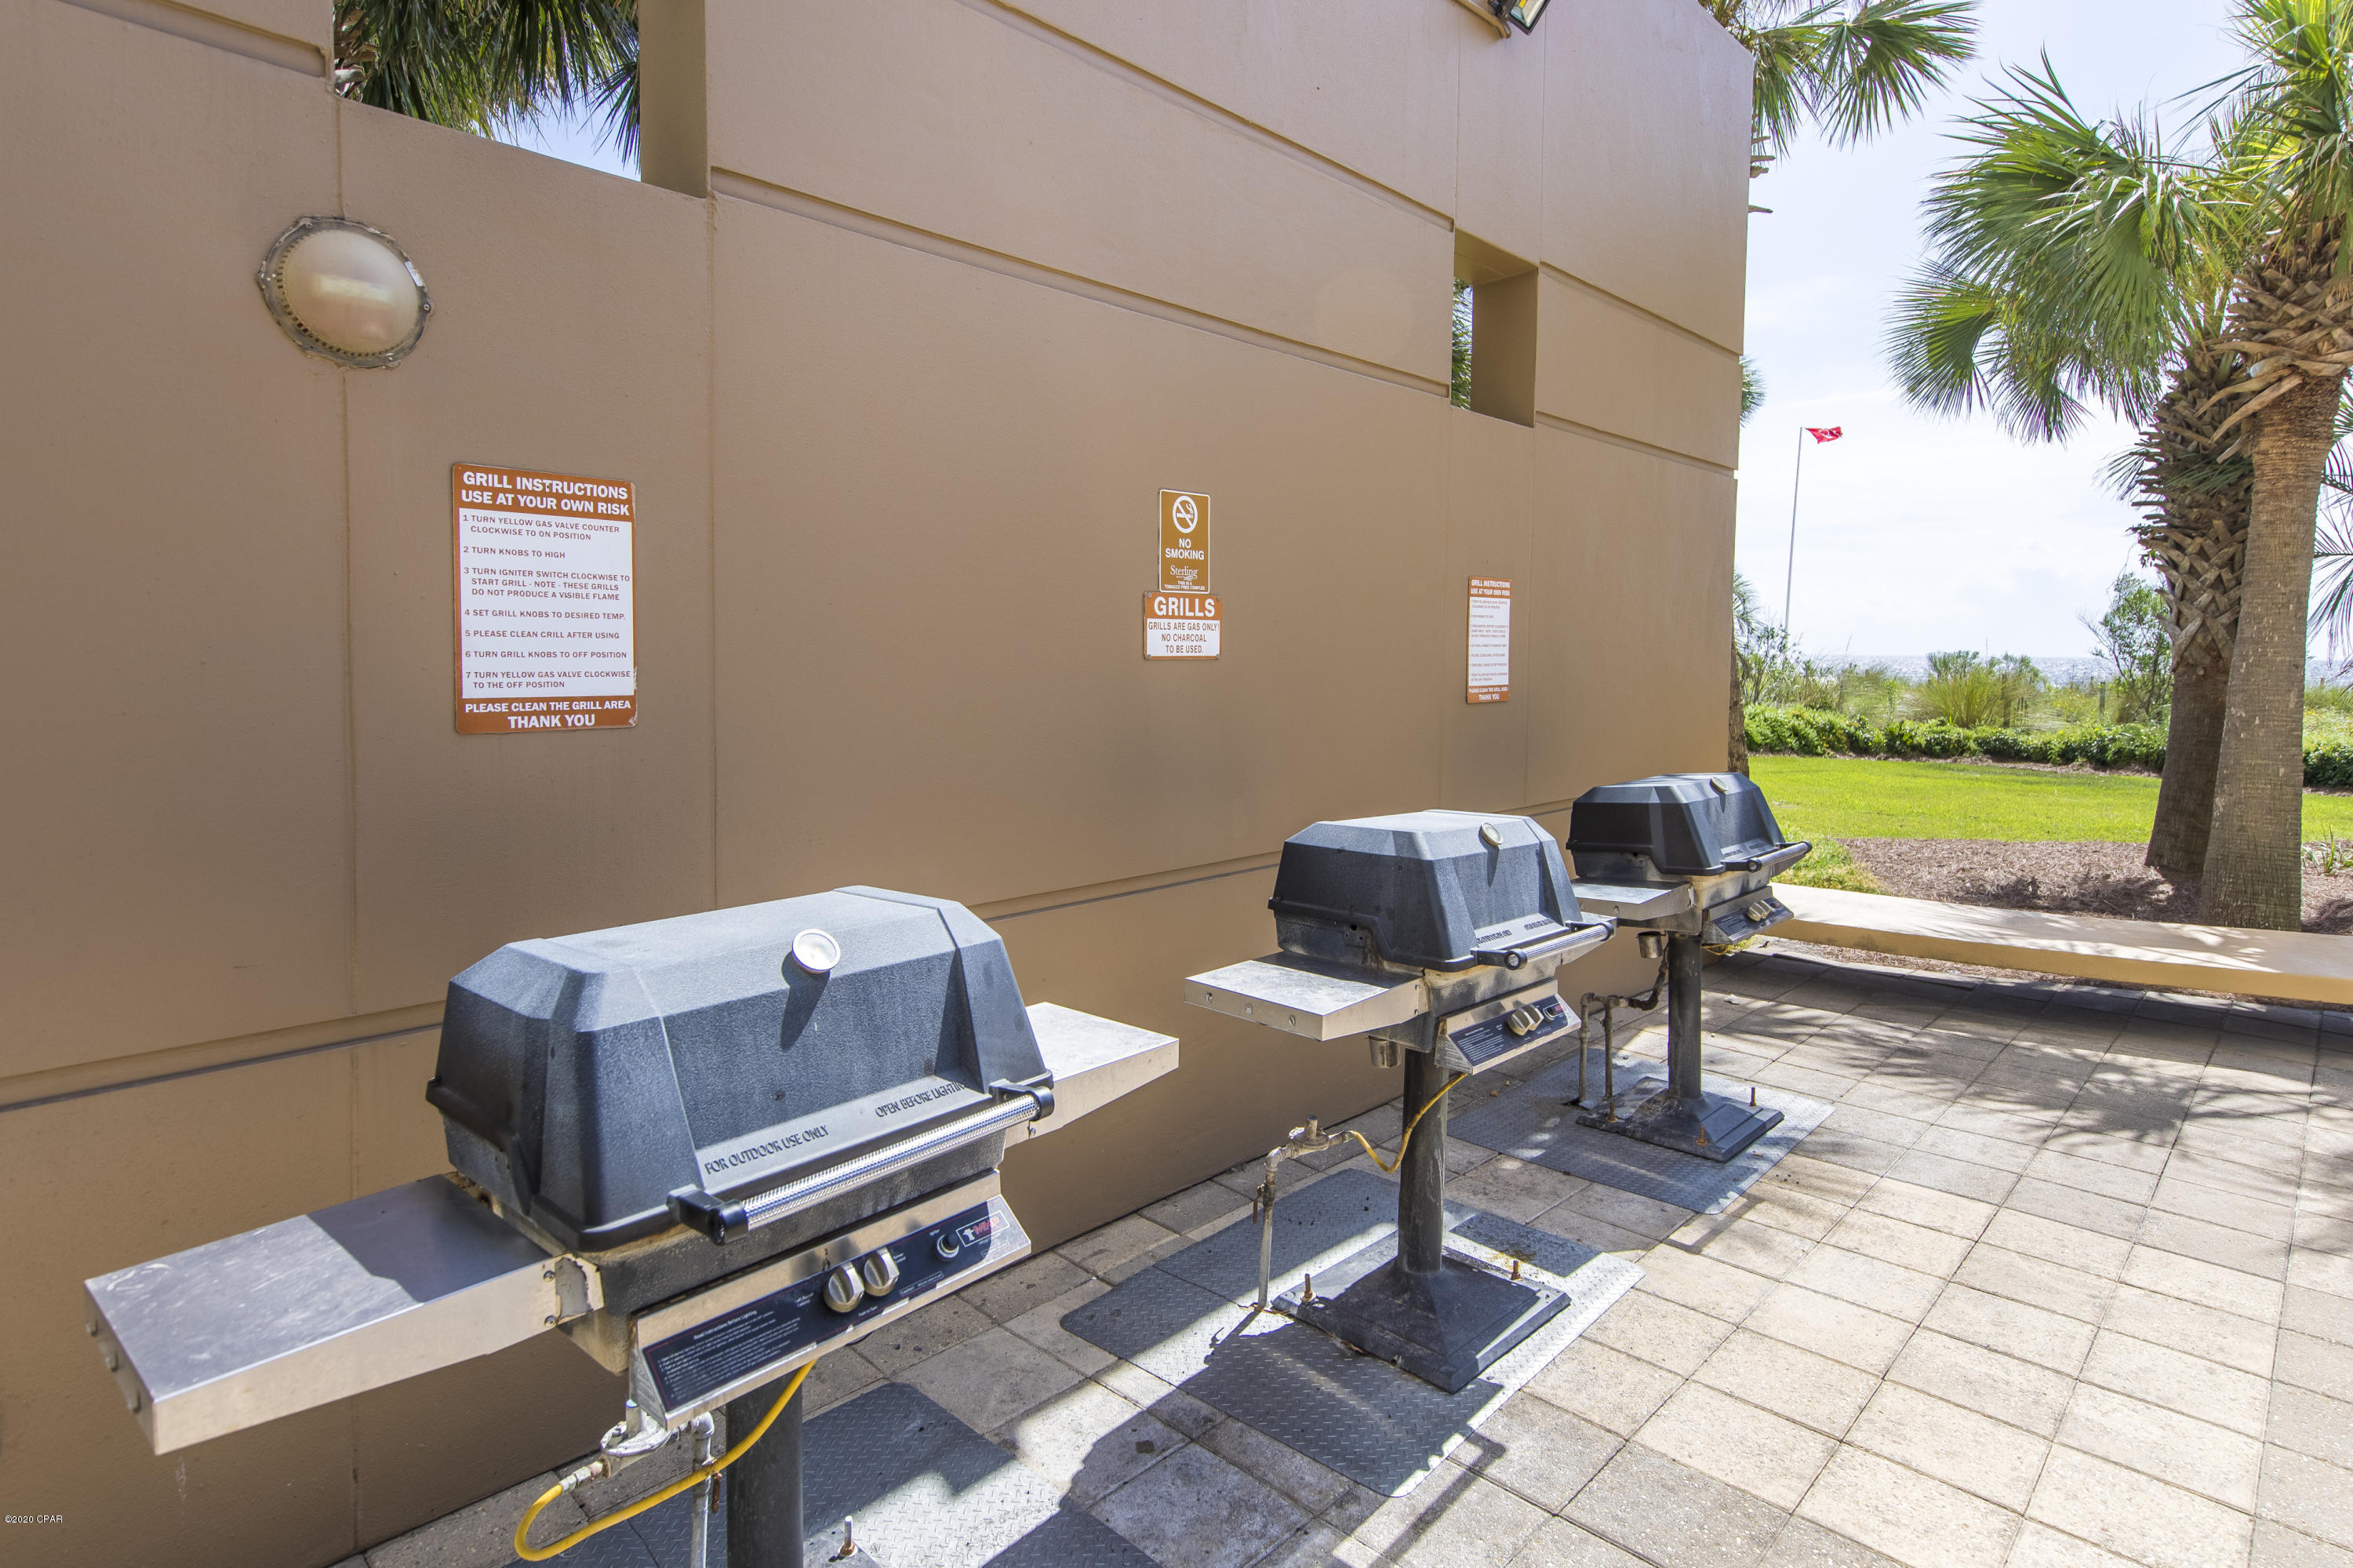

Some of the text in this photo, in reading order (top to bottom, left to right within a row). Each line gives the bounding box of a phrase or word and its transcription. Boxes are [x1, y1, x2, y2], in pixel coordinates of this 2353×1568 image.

[463, 471, 627, 500] GRILL INSTRUCTIONS
[460, 489, 629, 515] USE AT YOUR OWN RISK
[471, 515, 495, 523] TURN
[498, 517, 533, 526] YELLOW
[582, 523, 620, 533] COUNTER
[471, 526, 522, 536] CLOCKWISE
[553, 531, 591, 540] POSITION
[1179, 538, 1191, 548] NO
[1166, 548, 1205, 560] SMOKING
[570, 572, 618, 581] CLOCKWISE
[1170, 565, 1198, 579] Sterling
[1154, 596, 1215, 617] GRILLS
[1148, 621, 1171, 630] GRILLS
[1173, 622, 1185, 631] ARE
[1187, 622, 1200, 631] GAS
[1173, 634, 1207, 642] CHARCOAL
[1166, 645, 1174, 653] TO
[1176, 645, 1184, 653] BE
[464, 700, 631, 712] PLEASE CLEAN THE GRILL AREA
[507, 714, 595, 729] THANK YOU
[875, 1081, 966, 1118] OPEN BEFORE LIGHTIN
[704, 1125, 829, 1175] FOR OUTDOOR USE ONLY
